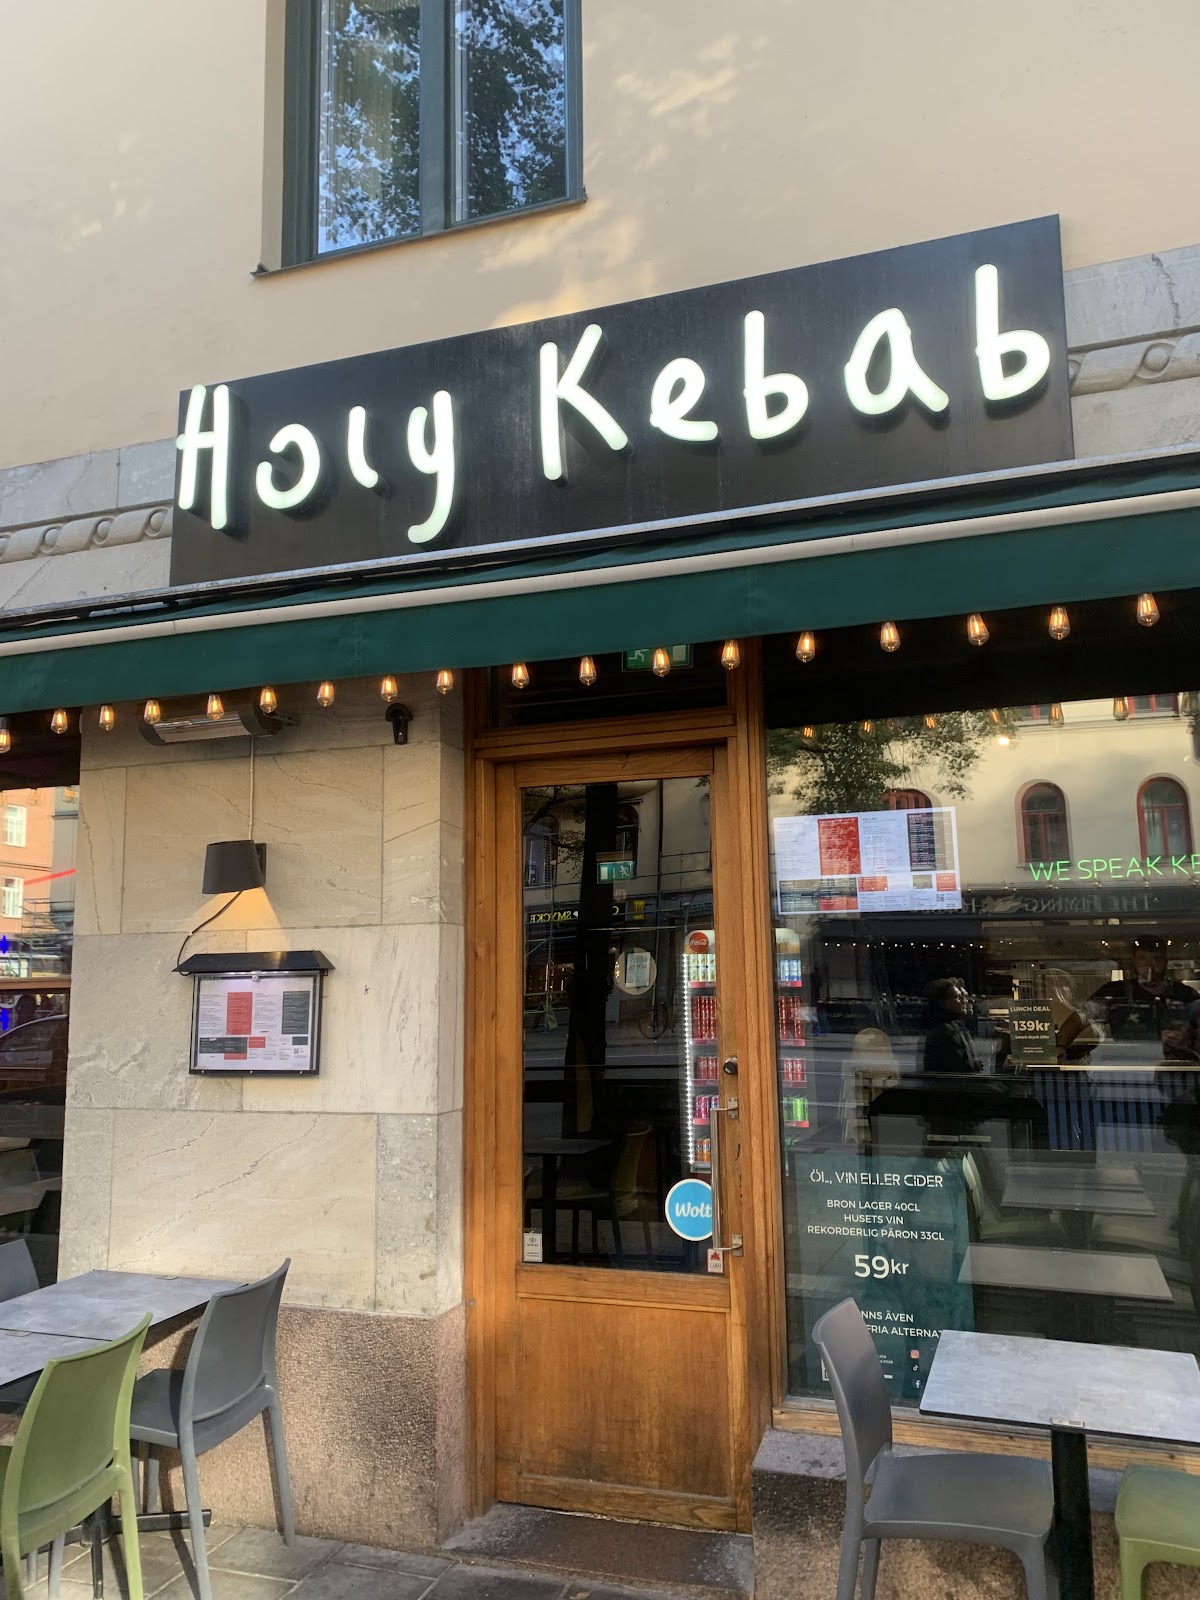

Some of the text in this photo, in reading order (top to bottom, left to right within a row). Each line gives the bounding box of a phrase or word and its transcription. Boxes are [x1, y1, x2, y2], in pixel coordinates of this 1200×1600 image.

[537, 264, 1051, 480] Kebab
[1029, 861, 1071, 881] WE
[1077, 856, 1163, 880] SPEAK
[1012, 1020, 1050, 1032] 139kr
[810, 1168, 944, 1188] ÖL, VIN ELLER CIDER
[675, 1201, 712, 1218] Wolt
[826, 1199, 921, 1212] BRON LAGER 40CL
[843, 1213, 904, 1225] HUSETS VIN
[807, 1225, 945, 1241] REKORDERLIG PÄRON 33CL
[854, 1254, 909, 1279] 59kr
[885, 1309, 914, 1323] ÄVEN
